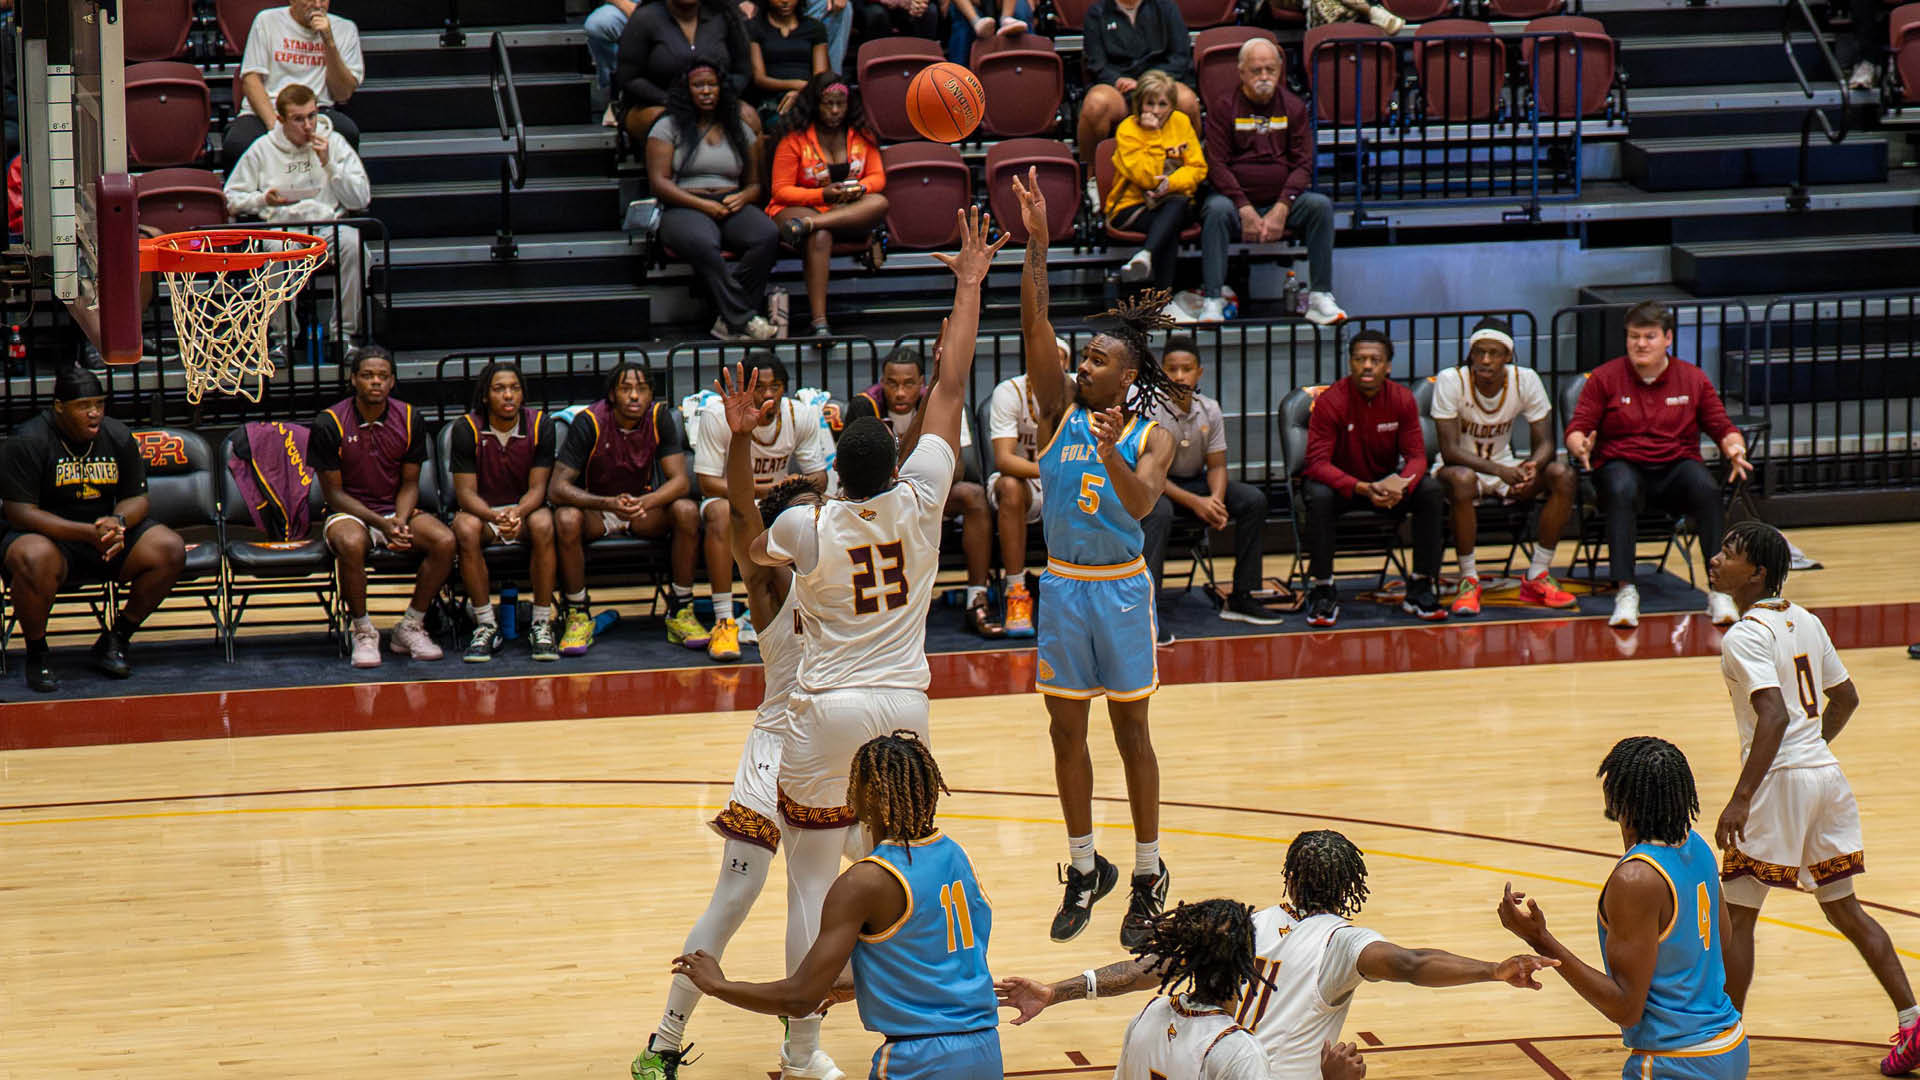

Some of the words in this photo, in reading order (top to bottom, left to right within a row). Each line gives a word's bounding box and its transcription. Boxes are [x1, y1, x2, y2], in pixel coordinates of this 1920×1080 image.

[88, 462, 118, 483] RIVER
[1077, 472, 1105, 515] 5
[846, 539, 909, 616] 23
[1792, 653, 1819, 720] 0
[939, 879, 974, 953] 11
[1697, 880, 1711, 951] 4
